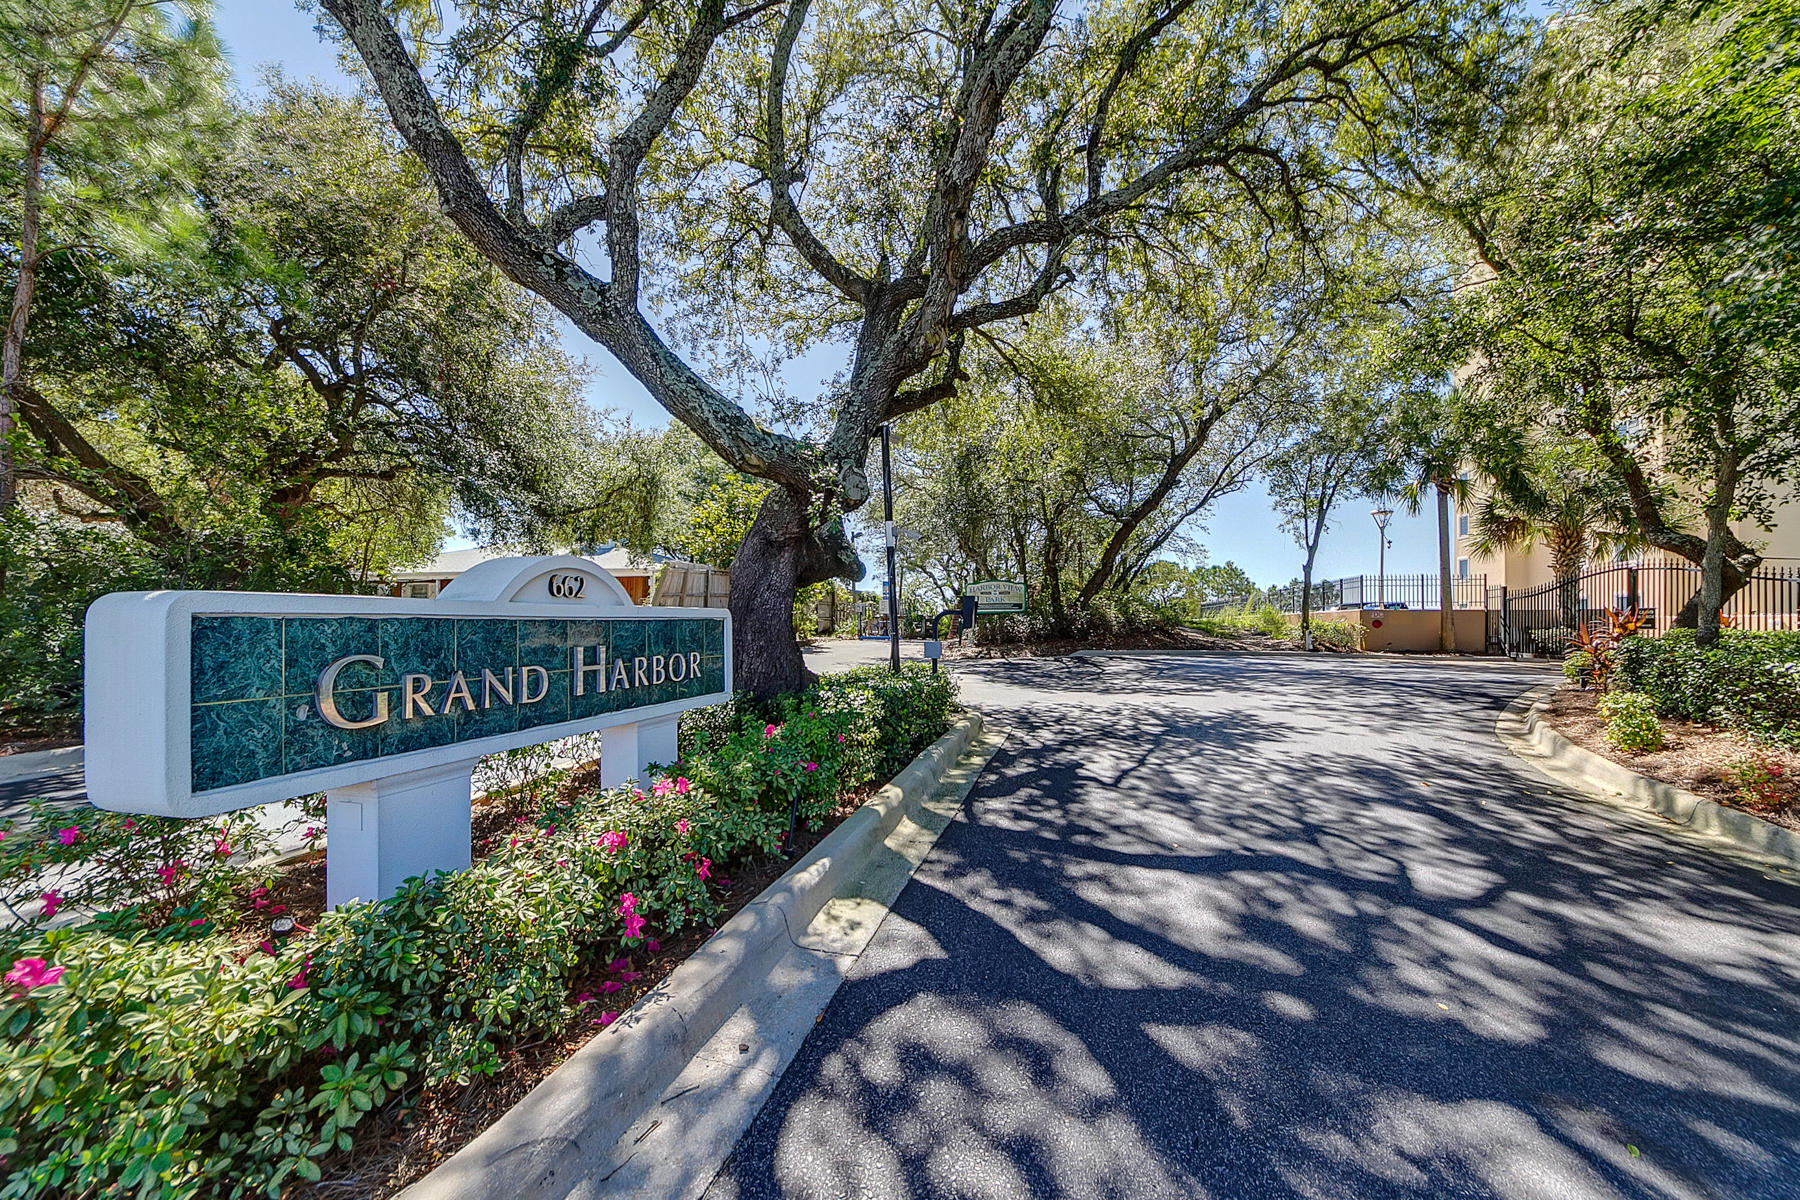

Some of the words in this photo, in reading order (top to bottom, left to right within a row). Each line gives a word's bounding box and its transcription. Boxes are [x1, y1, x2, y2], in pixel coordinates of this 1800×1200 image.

[548, 574, 586, 599] 662
[969, 583, 1001, 593] HARBOR
[1003, 585, 1023, 593] VIEW
[315, 654, 550, 730] GRAND
[573, 645, 702, 696] HARBOR
